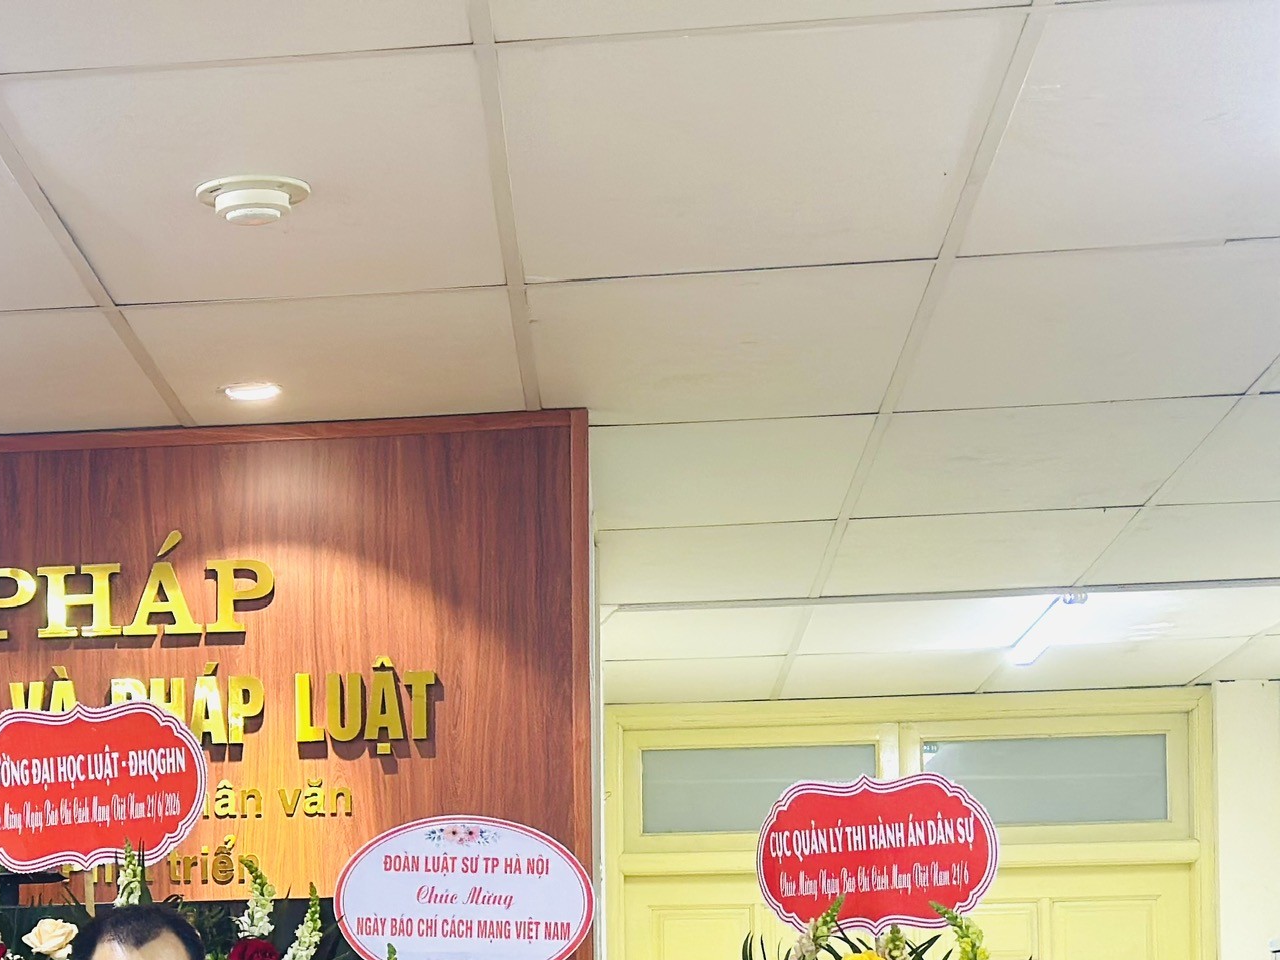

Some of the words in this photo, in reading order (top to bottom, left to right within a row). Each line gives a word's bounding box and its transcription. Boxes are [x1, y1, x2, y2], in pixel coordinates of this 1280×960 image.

[295, 655, 436, 754] LUẬT
[32, 758, 54, 791] ĐẠI
[57, 754, 86, 790] HỌC
[88, 744, 120, 786] LUẬT
[128, 746, 186, 783] ĐHQGHN
[2, 802, 22, 835] Mừng
[23, 801, 43, 834] Ngày
[44, 799, 58, 826] Báo
[60, 798, 72, 825] Chí
[73, 797, 89, 824] Cách
[91, 796, 110, 827] Mạng
[111, 794, 126, 825] Việt
[128, 792, 146, 819] Nam
[147, 790, 180, 823] 21/6/2026
[279, 778, 353, 817] văn
[770, 831, 791, 864] CỤC
[792, 820, 828, 862] QUẢN
[829, 819, 845, 853] LÝ
[845, 825, 867, 851] THI
[869, 815, 905, 851] HÀNH
[907, 813, 926, 848] ÁN
[928, 811, 955, 845] DÂN
[956, 811, 975, 851] SỰ
[383, 851, 419, 873] ĐOÀN
[424, 852, 457, 877] LUẬT
[461, 854, 480, 874] SƯ
[483, 857, 499, 874] TP
[504, 852, 521, 875] HÀ
[526, 854, 550, 879] NỘI
[780, 872, 796, 897] Chúc
[798, 871, 817, 901] Mừng
[819, 869, 840, 900] Ngày
[841, 868, 855, 893] Báo
[858, 866, 870, 892] Chí
[872, 865, 888, 891] Cách
[891, 864, 911, 895] Mạng
[913, 863, 929, 892] Việt
[931, 862, 950, 886] Nam
[952, 861, 969, 891] 21/6
[416, 885, 458, 905] Chúc
[462, 886, 515, 910] Mừng
[356, 912, 387, 937] NGÀY
[390, 913, 413, 937] BÁO
[417, 914, 438, 938] CHÍ
[441, 914, 473, 939] CÁCH
[477, 919, 510, 944] MẠNG
[514, 917, 541, 945] VIỆT
[544, 922, 571, 941] NAM
